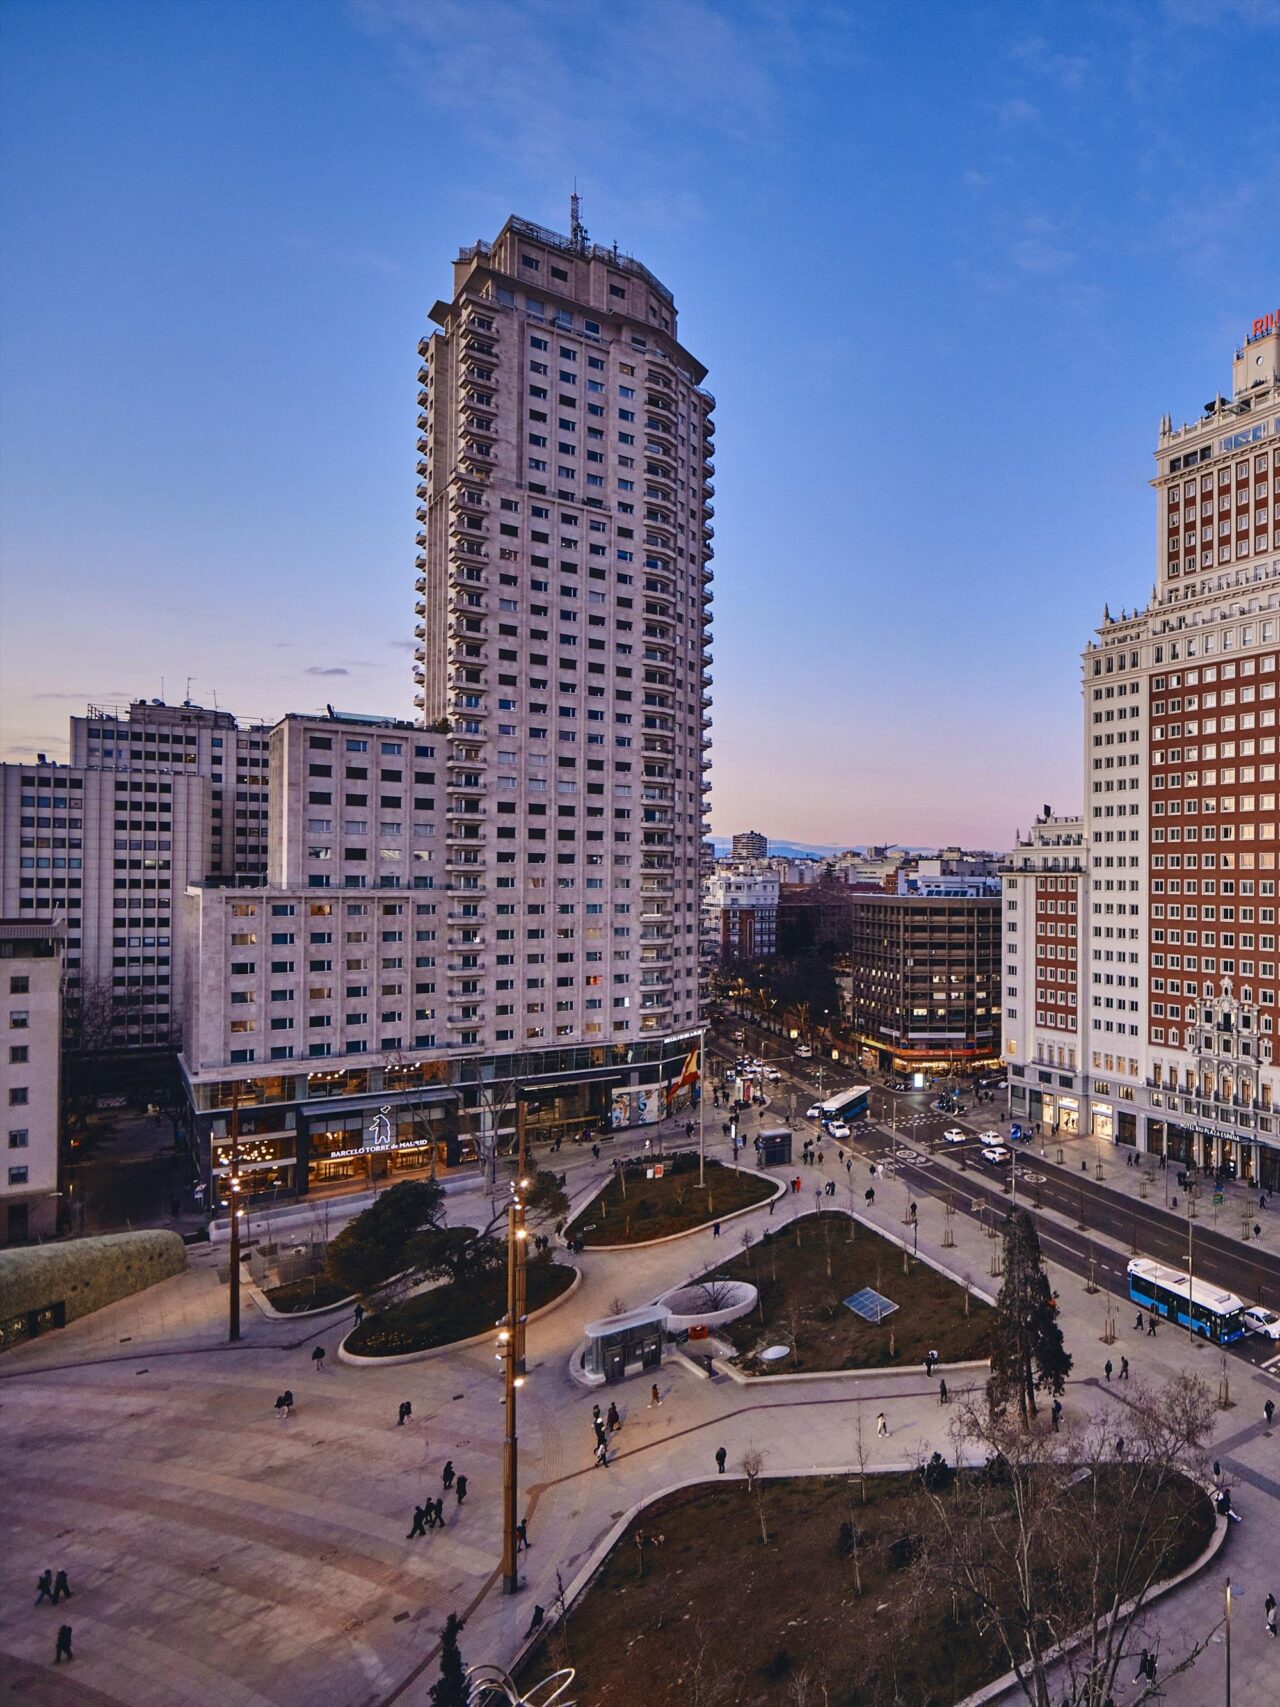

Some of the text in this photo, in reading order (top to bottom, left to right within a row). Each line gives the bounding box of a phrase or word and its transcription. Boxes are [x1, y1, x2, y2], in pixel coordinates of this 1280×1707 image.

[1252, 309, 1280, 336] RIU
[1204, 1128, 1220, 1136] PLAZA
[365, 1144, 390, 1153] TORRE
